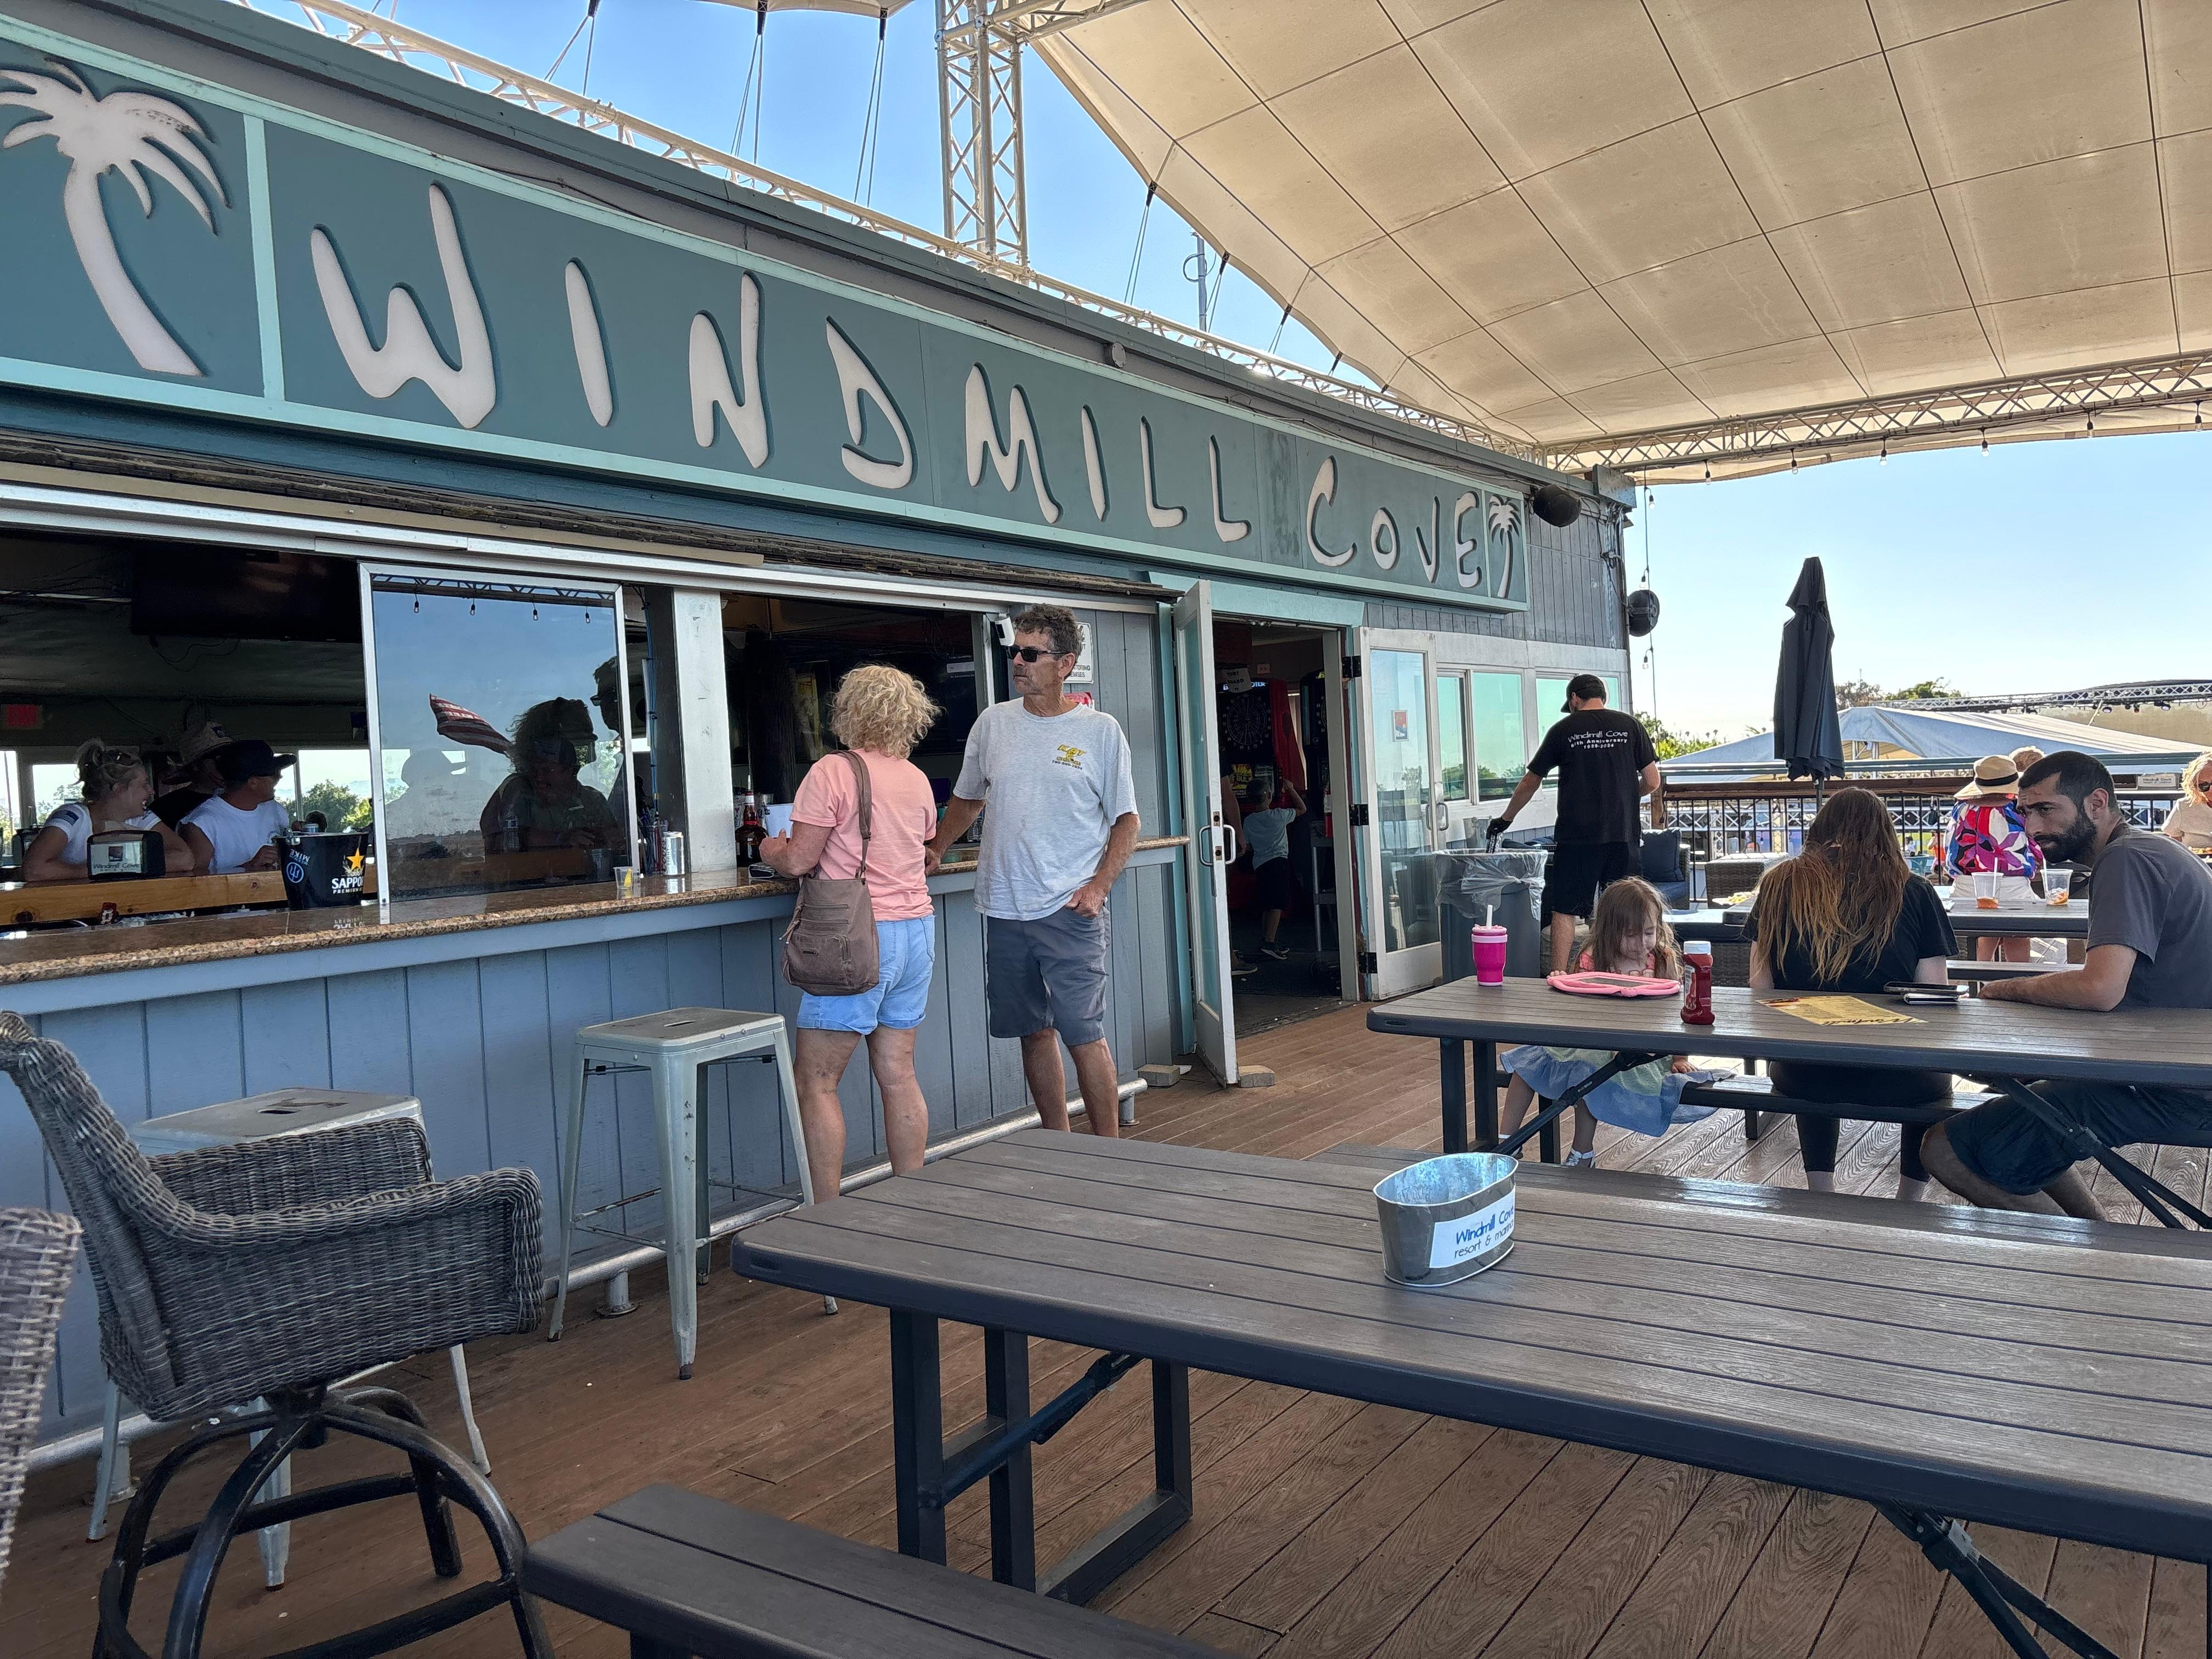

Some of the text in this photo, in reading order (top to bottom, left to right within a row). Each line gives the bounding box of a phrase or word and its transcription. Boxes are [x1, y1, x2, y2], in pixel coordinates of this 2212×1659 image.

[311, 182, 1482, 588] WINDMILL COVE
[1568, 730, 1602, 743] Windmill
[1454, 1218, 1514, 1259] resort & marina
[1455, 1214, 1496, 1245] Windmill
